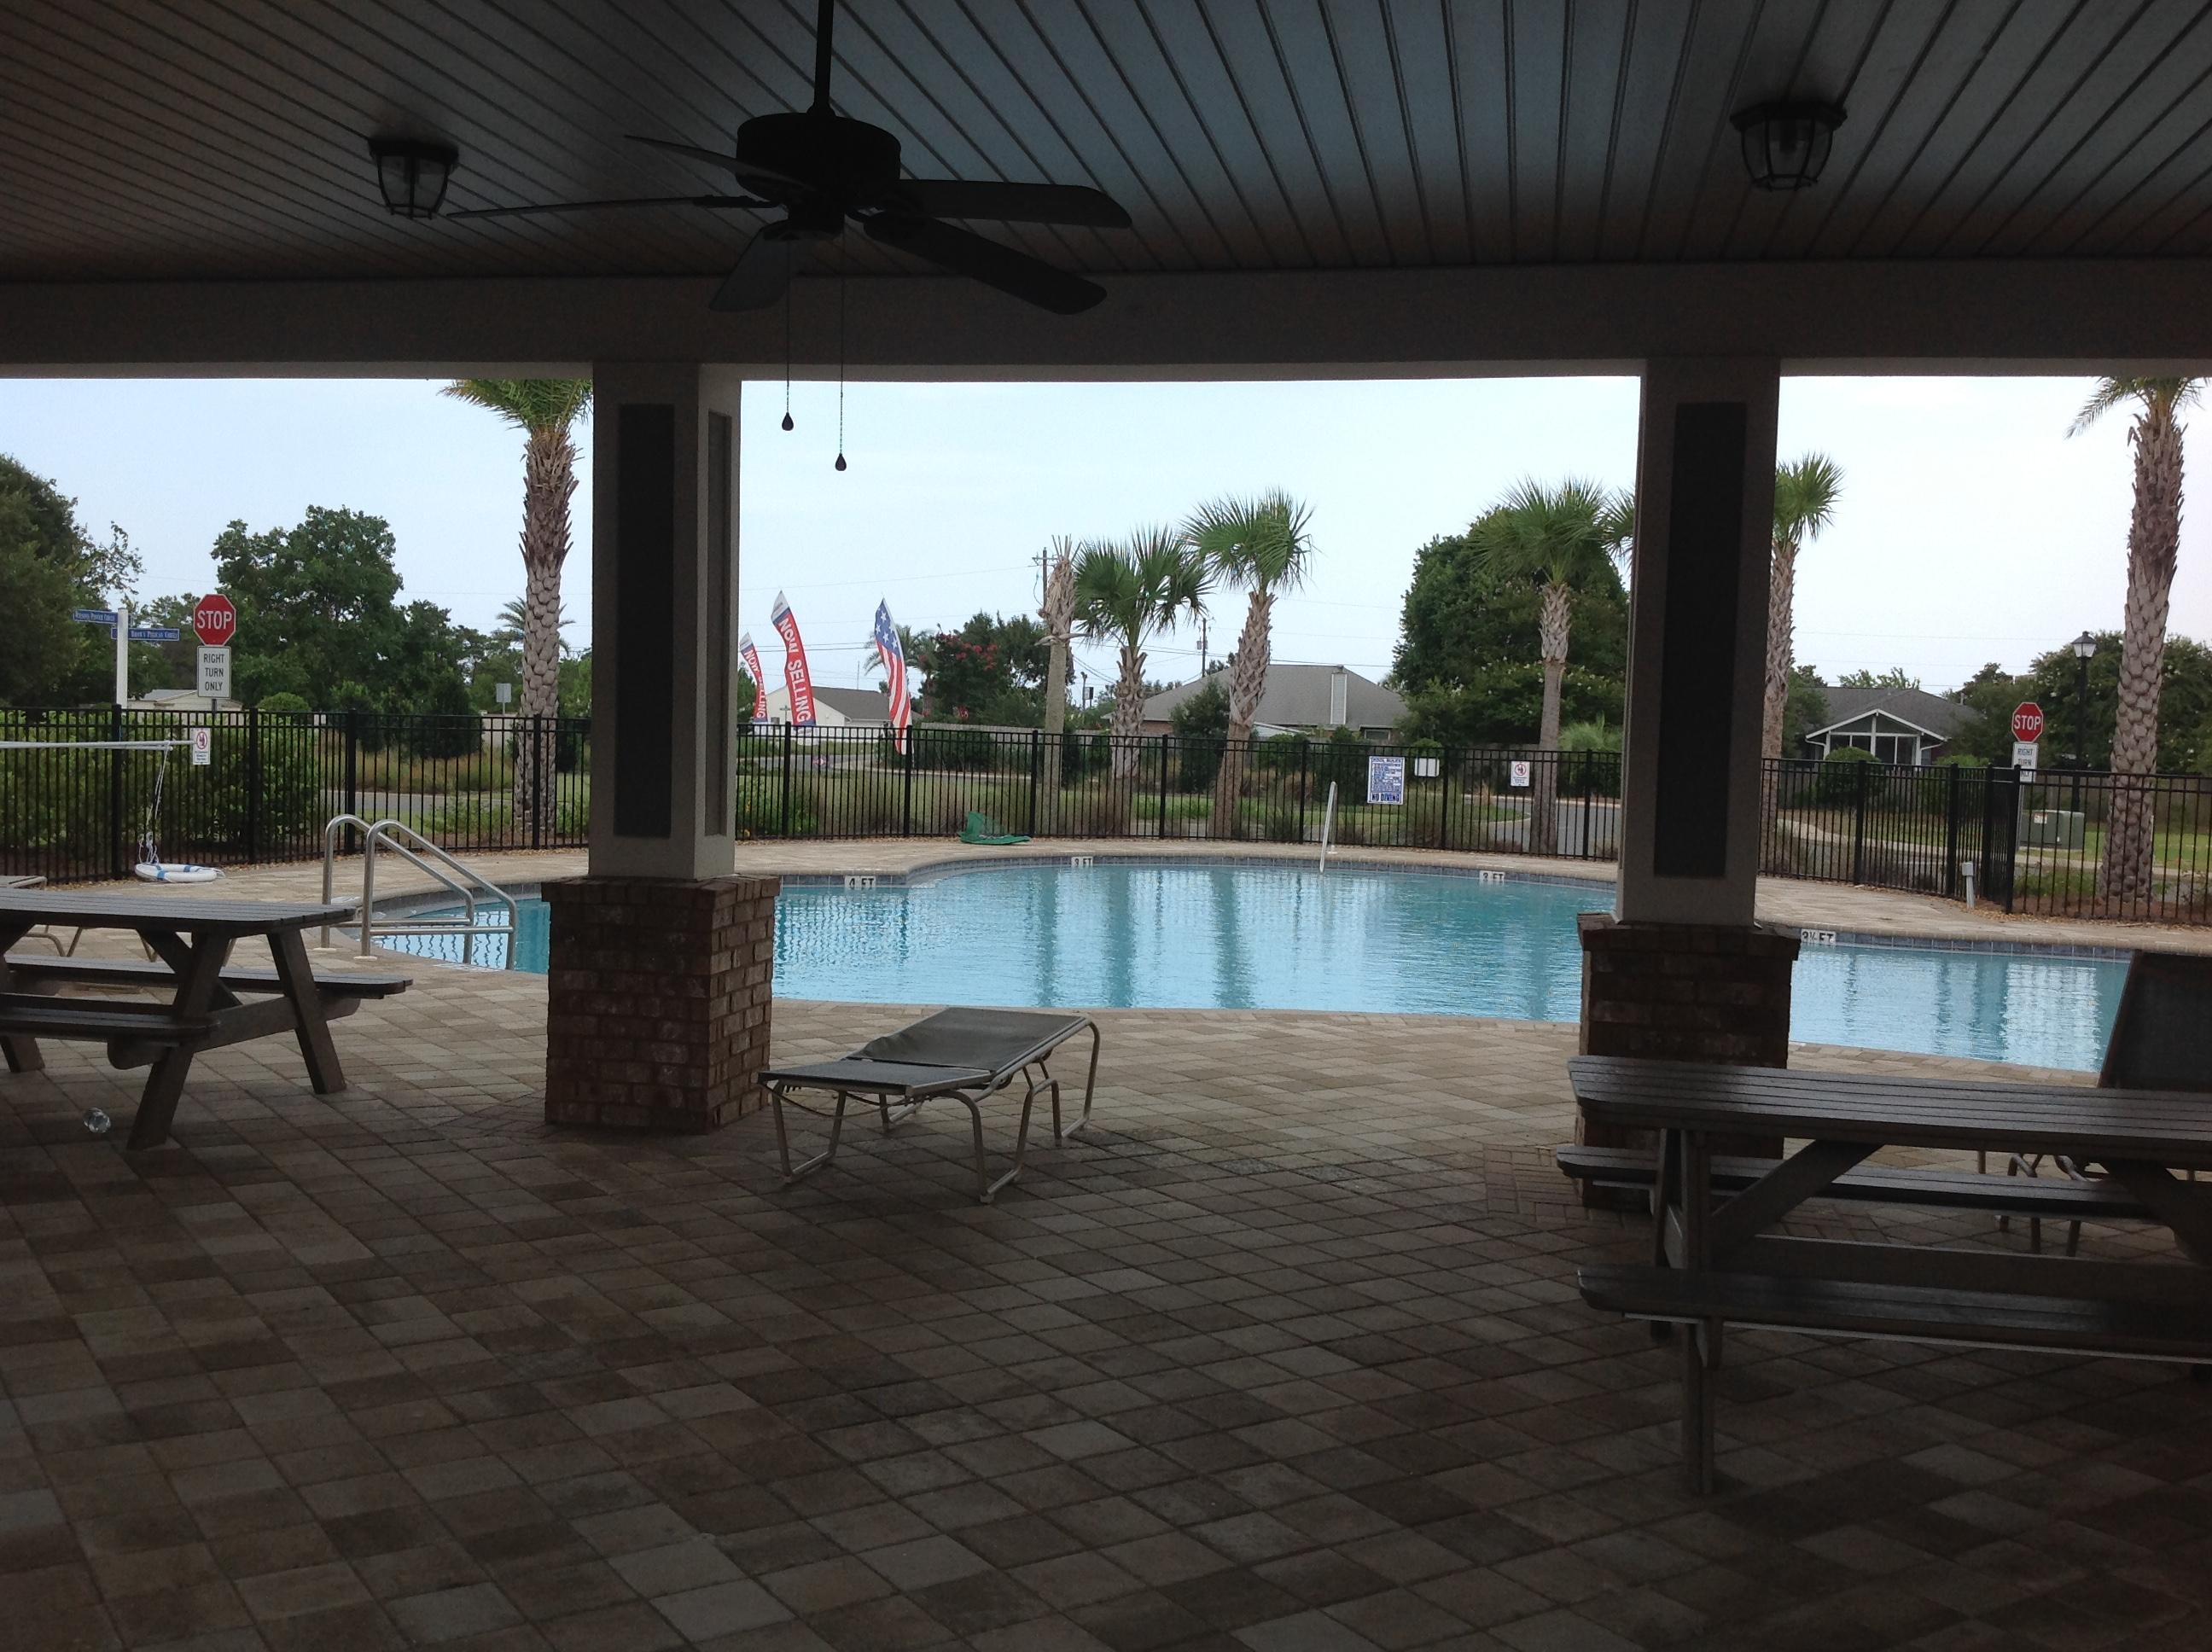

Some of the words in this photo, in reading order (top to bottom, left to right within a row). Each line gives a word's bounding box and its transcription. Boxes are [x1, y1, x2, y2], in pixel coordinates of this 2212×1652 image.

[197, 610, 232, 629] STOP
[779, 618, 799, 653] NOW
[204, 654, 224, 663] RIGHT
[744, 649, 760, 671] NOW
[205, 667, 224, 678] TURN
[205, 681, 223, 691] ONLY
[788, 660, 811, 722] SELLING
[2014, 715, 2041, 730] STOP
[861, 877, 874, 887] FT
